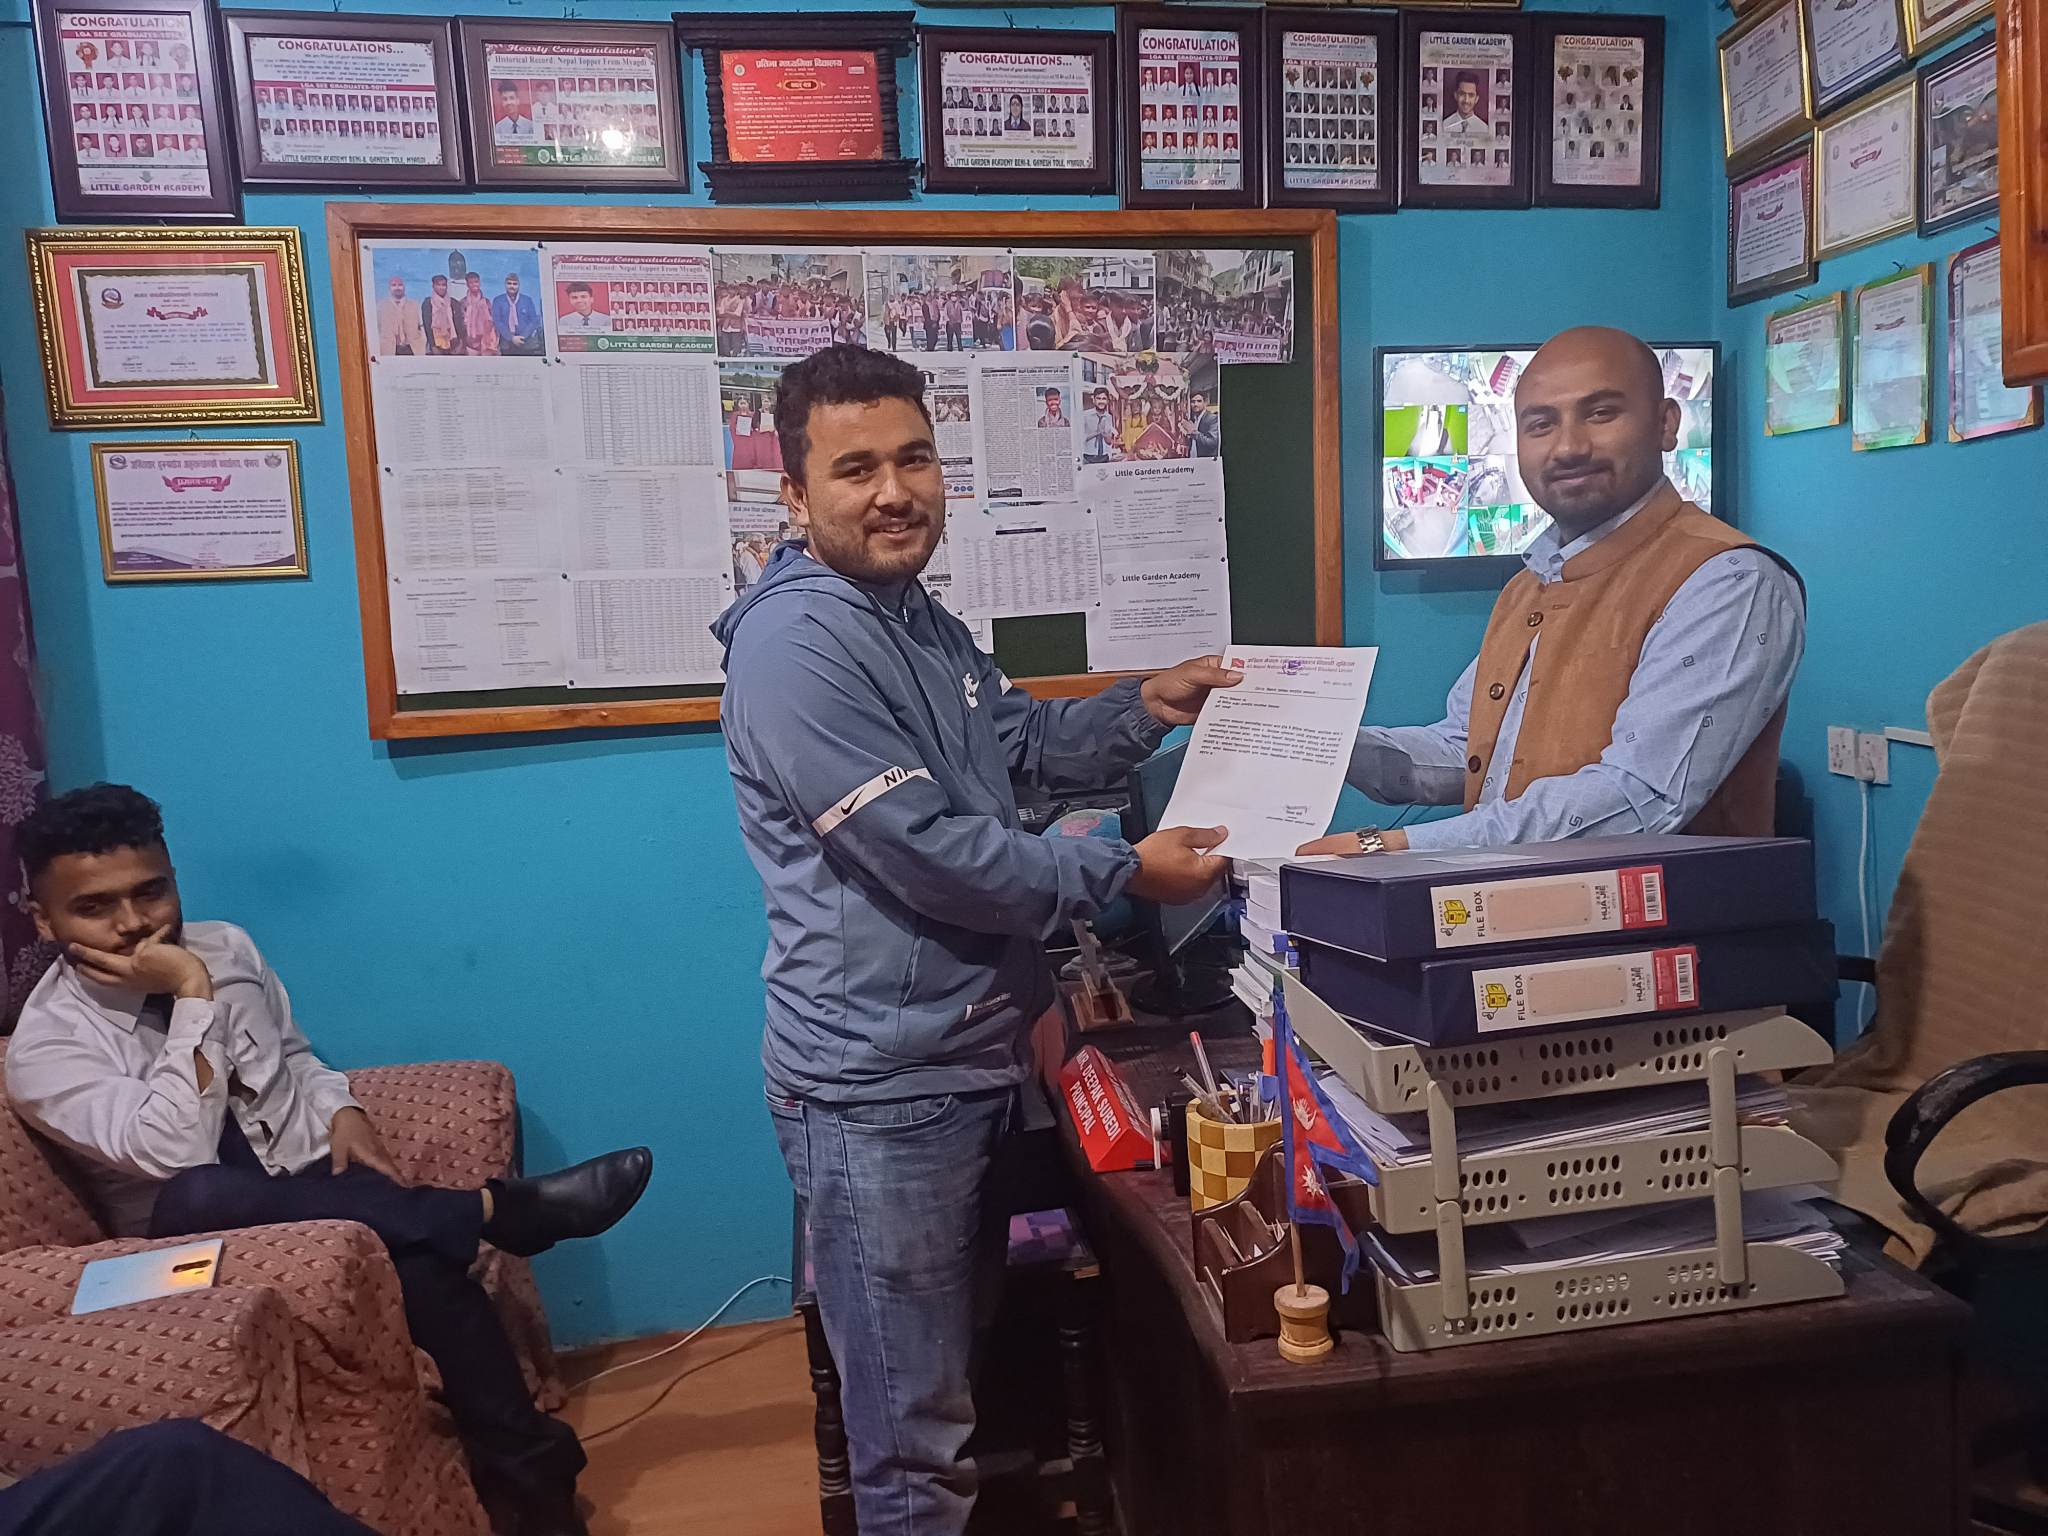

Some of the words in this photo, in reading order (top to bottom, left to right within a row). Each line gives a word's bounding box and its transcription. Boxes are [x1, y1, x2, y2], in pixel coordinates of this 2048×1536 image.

[1142, 36, 1236, 51] CONGRATULATION
[1292, 33, 1366, 45] CONGRATULATION
[1429, 36, 1451, 45] LITTLE
[1451, 36, 1477, 46] GARDEN
[1477, 37, 1507, 47] ACADEMY
[1564, 36, 1634, 47] CONGRATULATION
[557, 57, 577, 67] Nepal
[281, 153, 299, 162] LITTLE
[953, 158, 970, 167] LITTLE
[1155, 178, 1174, 186] LITTLE
[1289, 177, 1311, 185] LITTLE
[90, 183, 121, 192] LITTLE
[122, 183, 161, 192] GARDEN
[163, 184, 206, 192] ACADEMY
[1114, 469, 1134, 477] Little
[1134, 468, 1161, 476] Garden
[1162, 466, 1195, 474] Academy
[1121, 574, 1141, 582] Little
[1141, 573, 1168, 581] Garden
[1169, 571, 1201, 580] Academy
[1473, 890, 1484, 912] BOX
[1476, 916, 1486, 938] FILE
[1513, 974, 1524, 996] BOX
[1516, 999, 1526, 1021] FILE
[1069, 1080, 1097, 1136] PRINCIPAL
[1082, 1063, 1106, 1105] DEEPAK
[1096, 1097, 1122, 1143] SUBEDI
